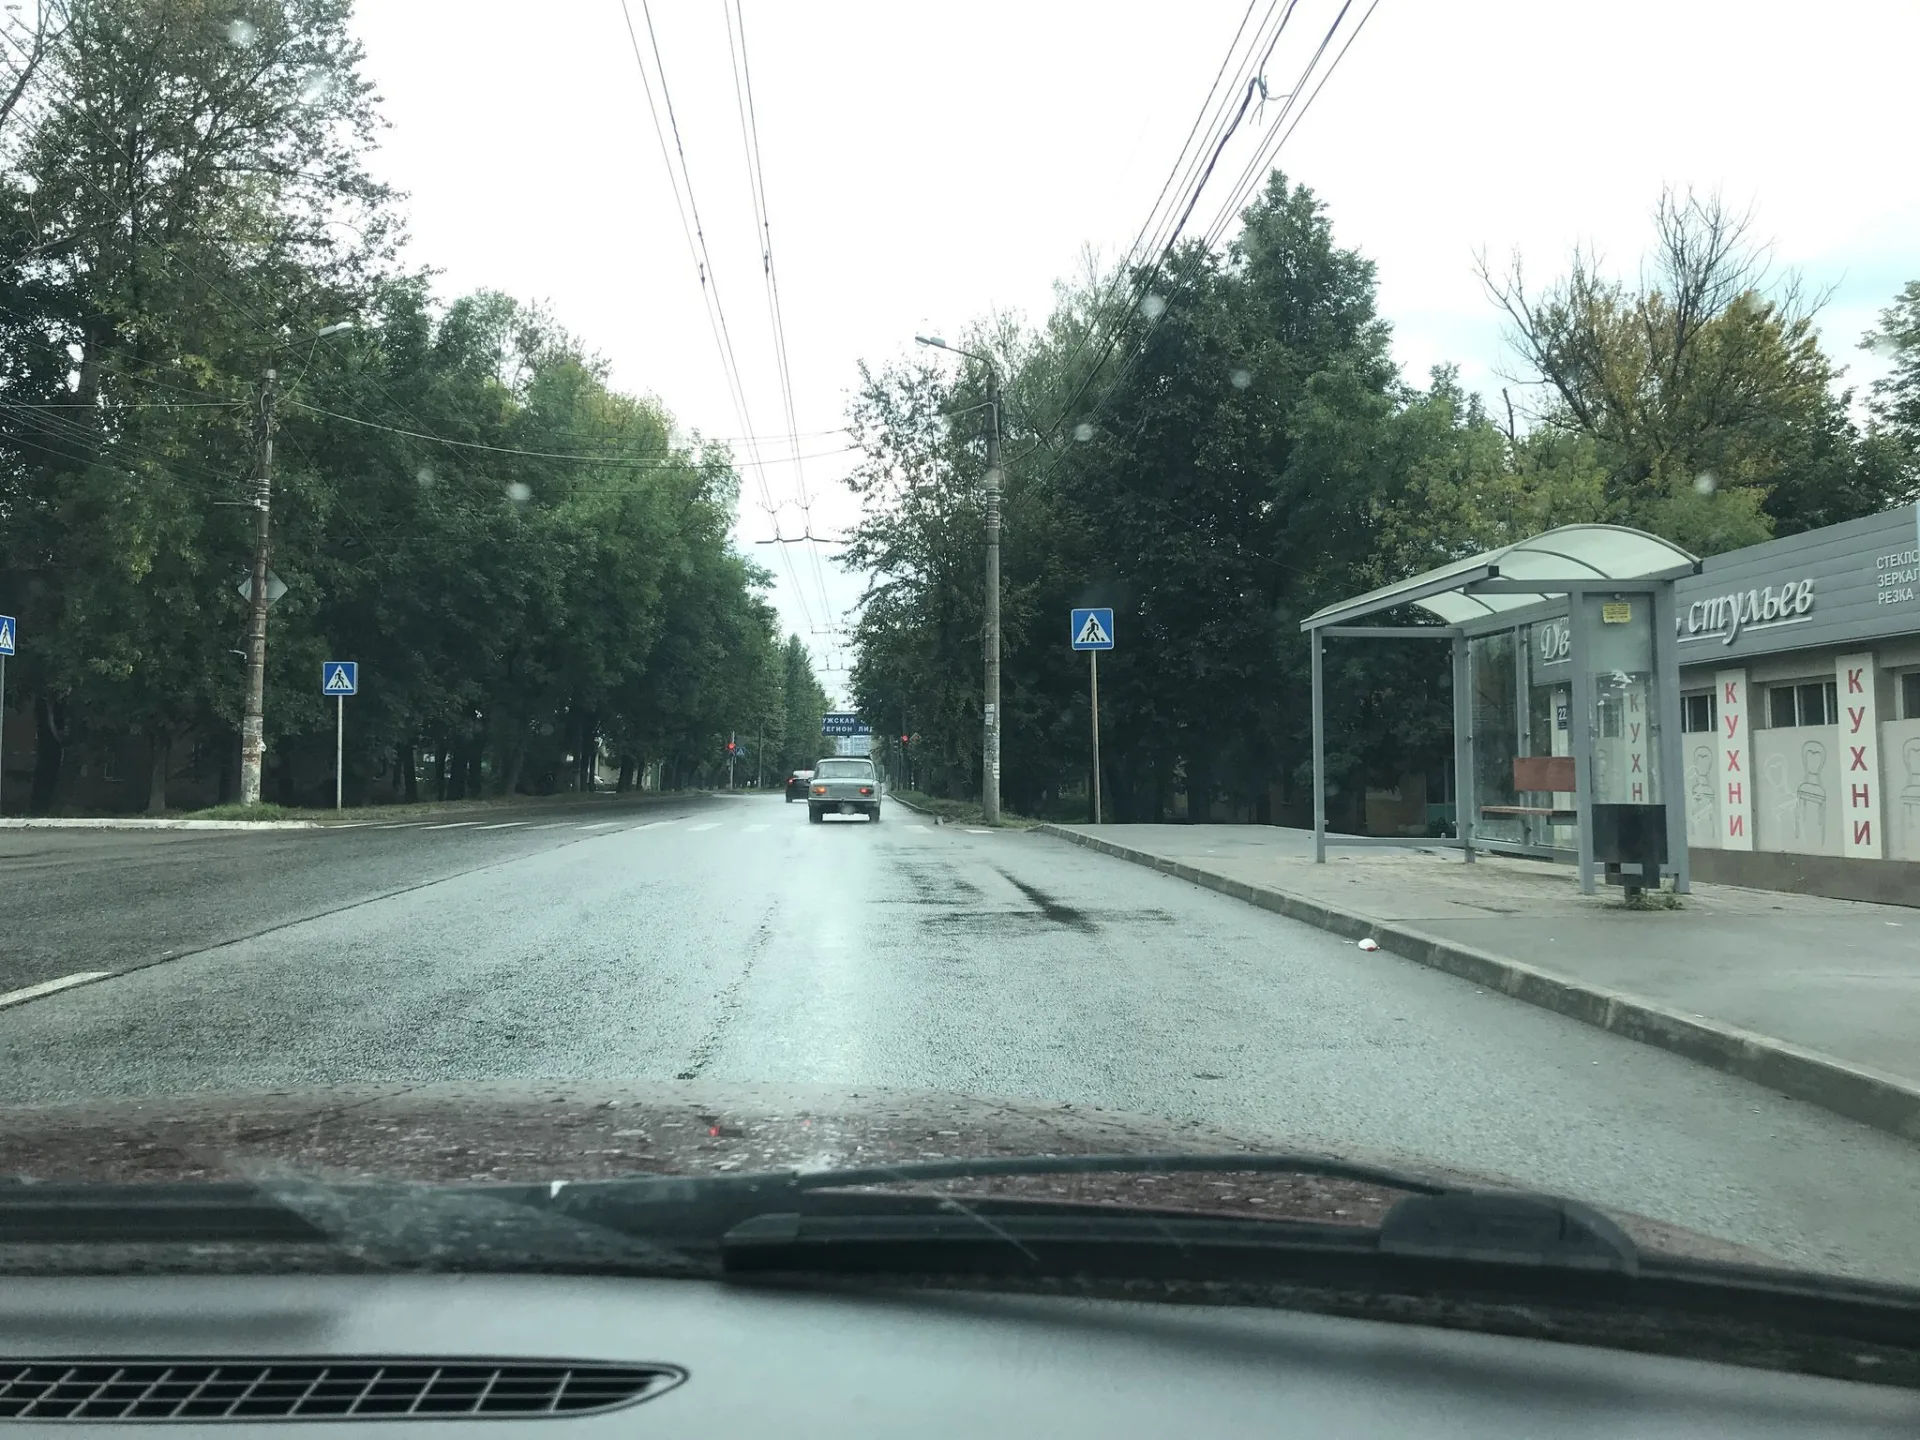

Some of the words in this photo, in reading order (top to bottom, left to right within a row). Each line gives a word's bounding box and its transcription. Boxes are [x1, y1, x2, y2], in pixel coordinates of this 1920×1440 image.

[1688, 578, 1815, 645] стульев
[1878, 587, 1915, 605] РЕЗКА
[1558, 707, 1567, 721] 22
[1629, 692, 1643, 802] КУХН
[1847, 668, 1872, 846] КУХНИ
[1724, 682, 1744, 837] КУХНИ
